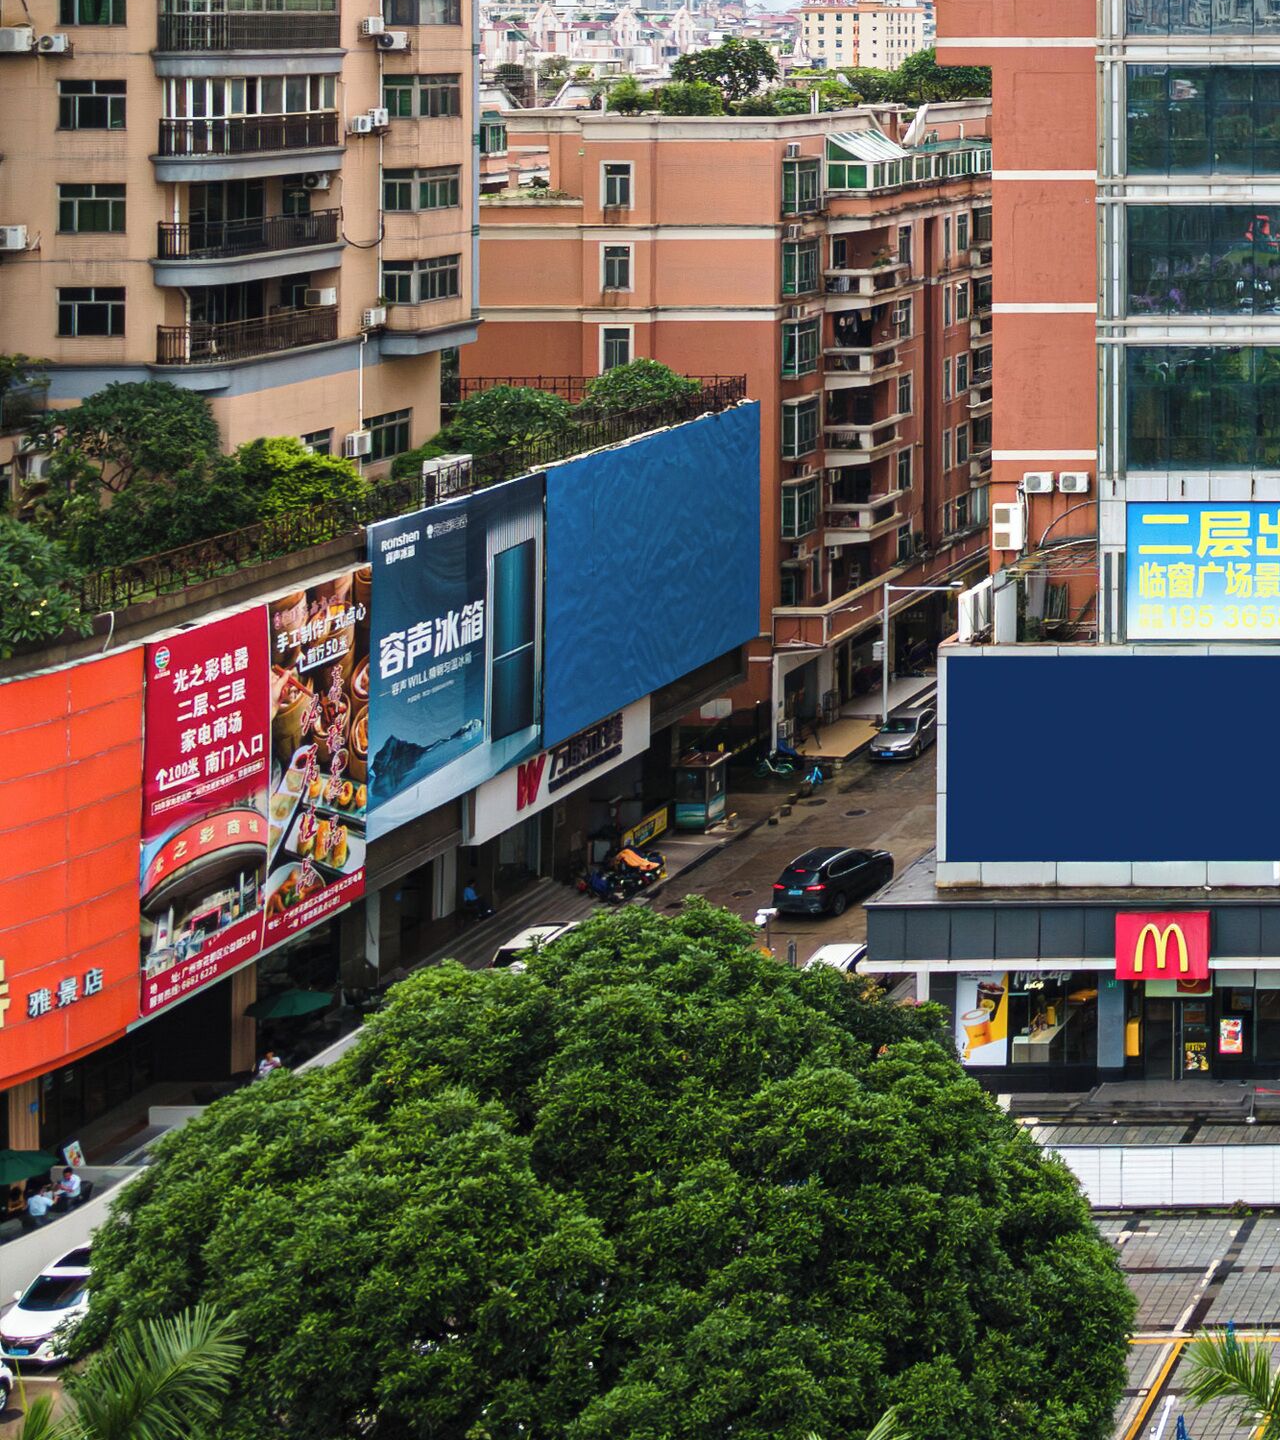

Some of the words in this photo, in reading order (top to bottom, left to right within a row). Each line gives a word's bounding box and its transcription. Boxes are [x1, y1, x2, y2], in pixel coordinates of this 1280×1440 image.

[381, 530, 420, 552] Ronshen
[1168, 604, 1214, 629] 195
[379, 600, 485, 679] 容声冰箱
[173, 646, 249, 694] 光之彩电器
[177, 678, 246, 722] 二层、三层
[180, 710, 243, 753] 家电商场
[204, 734, 264, 776] 南门入口
[28, 967, 104, 1018] 雅景店
